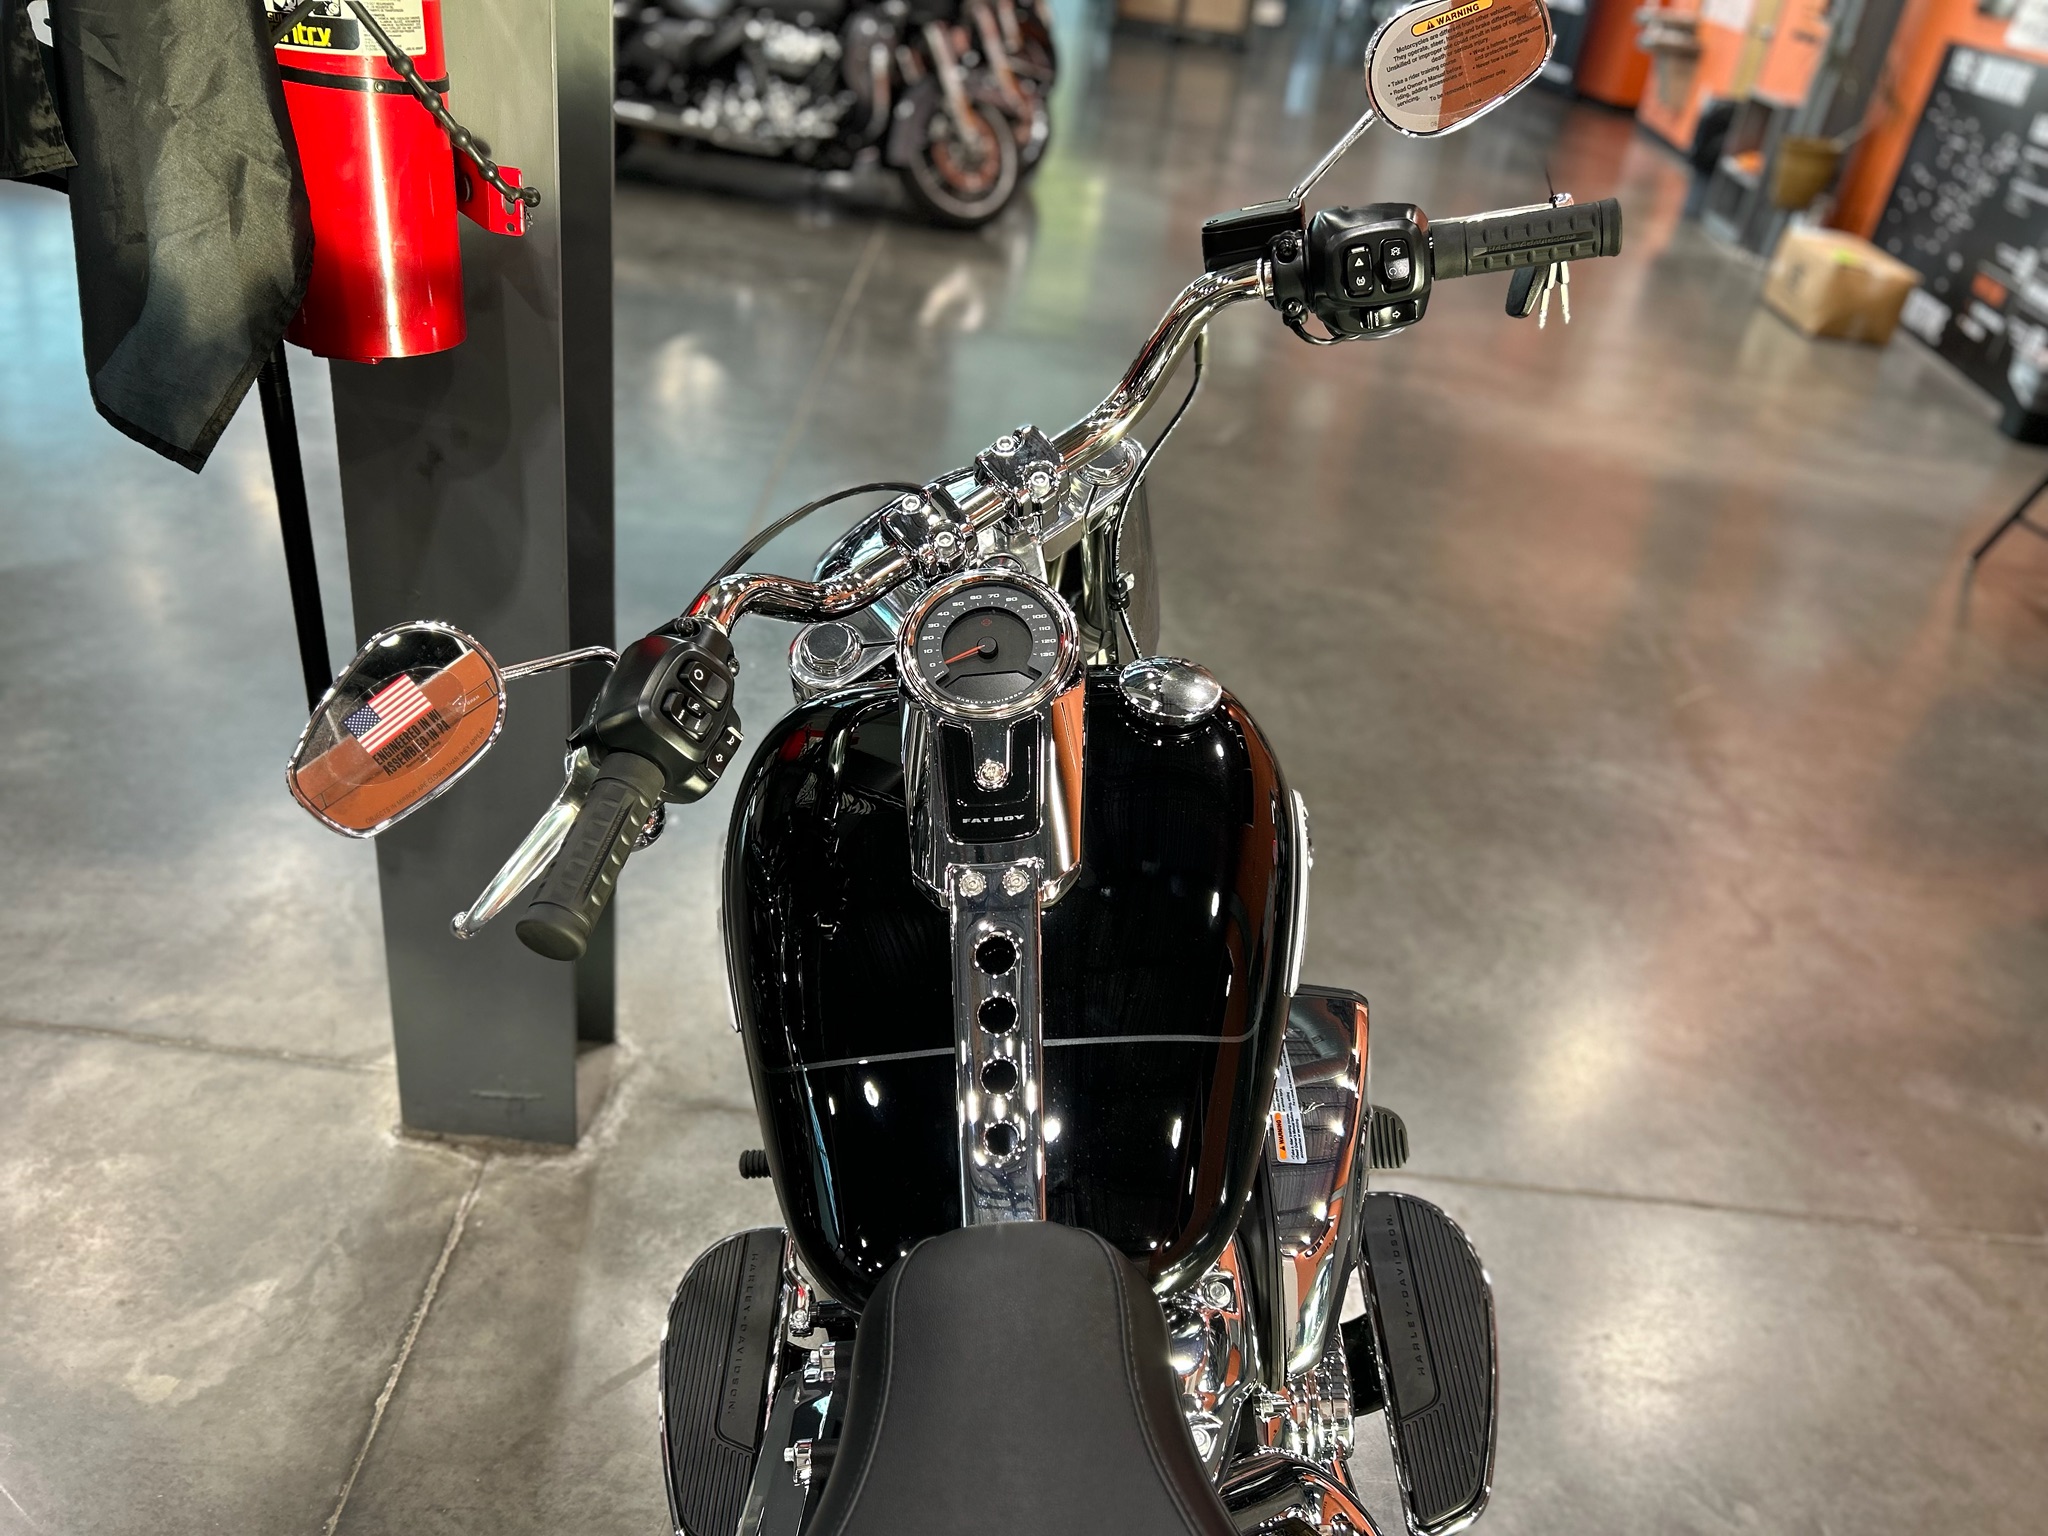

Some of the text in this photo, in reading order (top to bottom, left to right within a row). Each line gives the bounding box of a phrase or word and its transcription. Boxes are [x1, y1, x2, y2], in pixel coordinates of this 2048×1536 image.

[1437, 3, 1480, 25] WARNING
[1393, 52, 1407, 62] They
[1445, 30, 1463, 41] handle
[1463, 26, 1475, 34] and
[1474, 19, 1490, 30] brake
[1395, 36, 1429, 54] Motorcycles
[1438, 23, 1461, 36] different
[1461, 18, 1474, 27] from
[1474, 12, 1489, 22] other
[1472, 46, 1485, 55] Wear
[1516, 23, 1542, 38] protection
[1387, 58, 1411, 73] Unskilled
[1417, 46, 1443, 61] improper
[1453, 36, 1468, 46] could
[1490, 23, 1501, 31] loss
[1430, 52, 1446, 63] death
[1453, 42, 1473, 54] serious
[1483, 44, 1509, 58] protective
[1391, 78, 1404, 87] Take
[1407, 71, 1420, 80] rider
[1420, 64, 1440, 76] training
[1475, 60, 1490, 69] Never
[1393, 64, 1462, 95] Read Owner's Manual before
[1410, 84, 1428, 95] adding
[1427, 73, 1457, 88] accessories
[1443, 83, 1467, 96] removed
[1472, 72, 1495, 85] customer
[1396, 94, 1420, 108] servicing.
[371, 723, 422, 766] ENGINEERED
[417, 716, 431, 731] IN
[426, 707, 442, 723] WI
[381, 734, 431, 776] ASSEMBLED
[426, 727, 439, 741] IN
[435, 718, 450, 733] PA
[365, 807, 390, 824] OBJECTS
[396, 788, 418, 806] MIRROR
[416, 780, 429, 792] ARE
[426, 765, 448, 784] CLOSER
[445, 755, 460, 768] THAN
[457, 744, 471, 757] THEY
[467, 727, 486, 745] APPEAR
[994, 814, 1025, 822] BOY
[1275, 1119, 1284, 1144] WARNING
